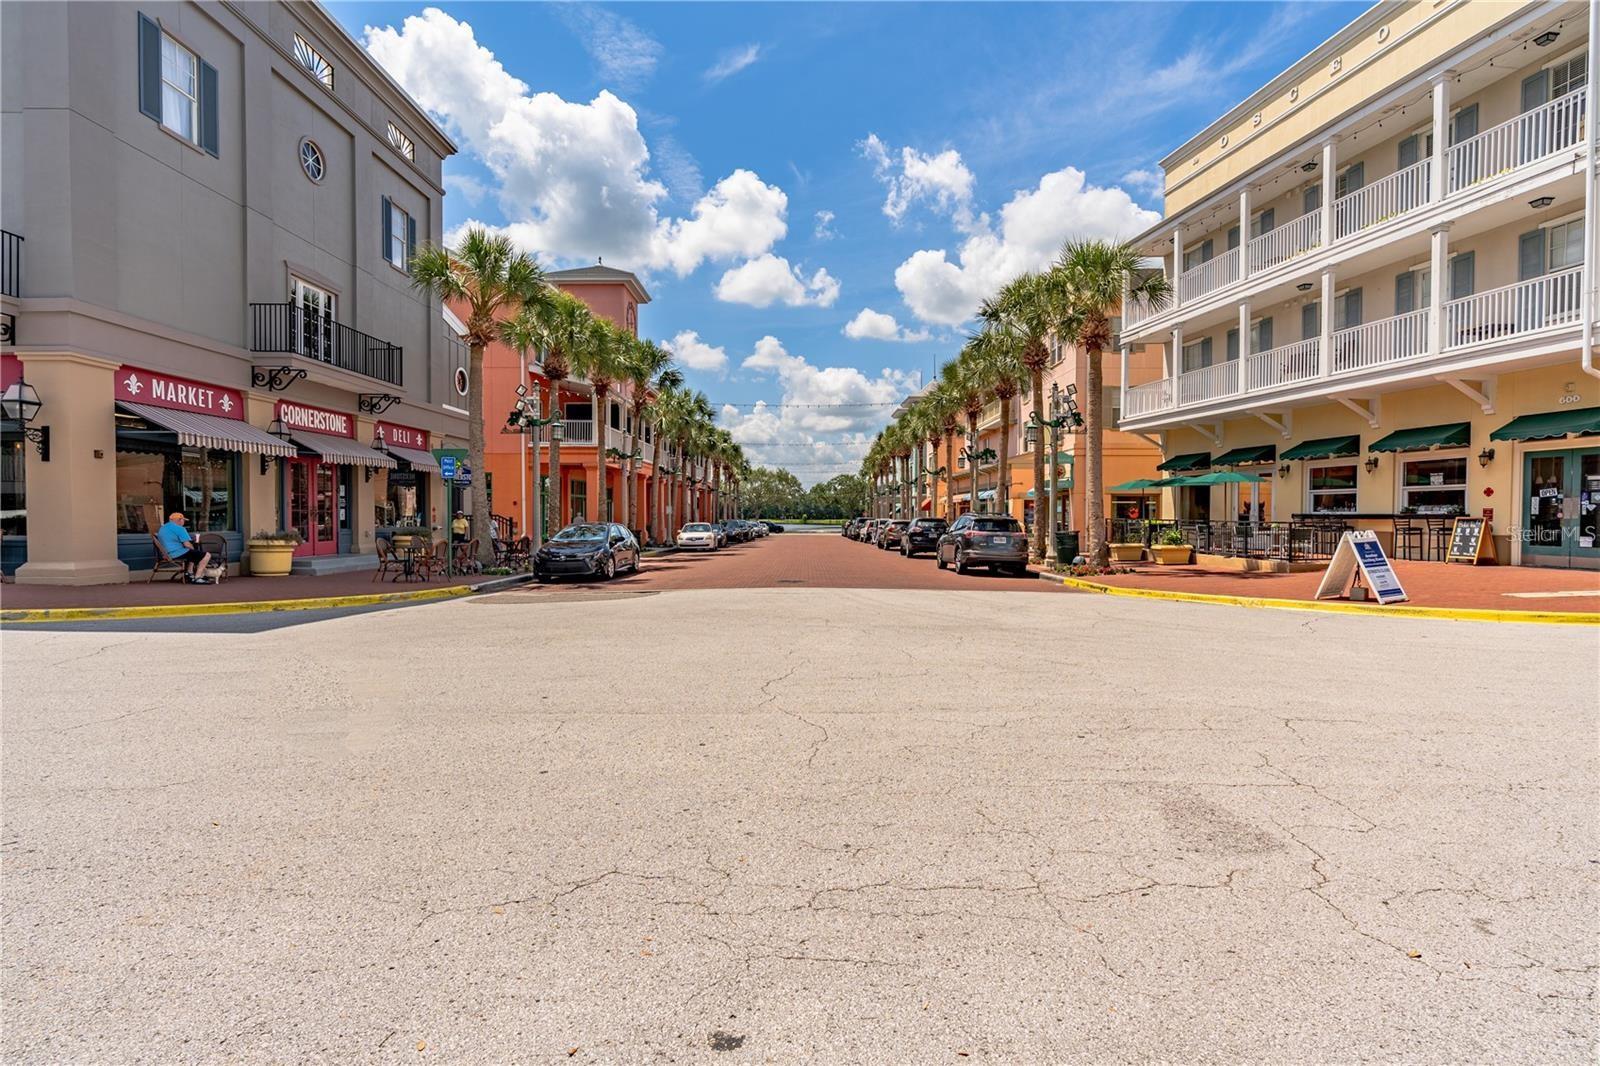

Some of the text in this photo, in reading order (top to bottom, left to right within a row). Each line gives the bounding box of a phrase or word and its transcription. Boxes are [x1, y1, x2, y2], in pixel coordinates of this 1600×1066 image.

[152, 379, 214, 409] MARKET
[281, 404, 347, 433] CORNERSTONE
[392, 428, 411, 444] DELI
